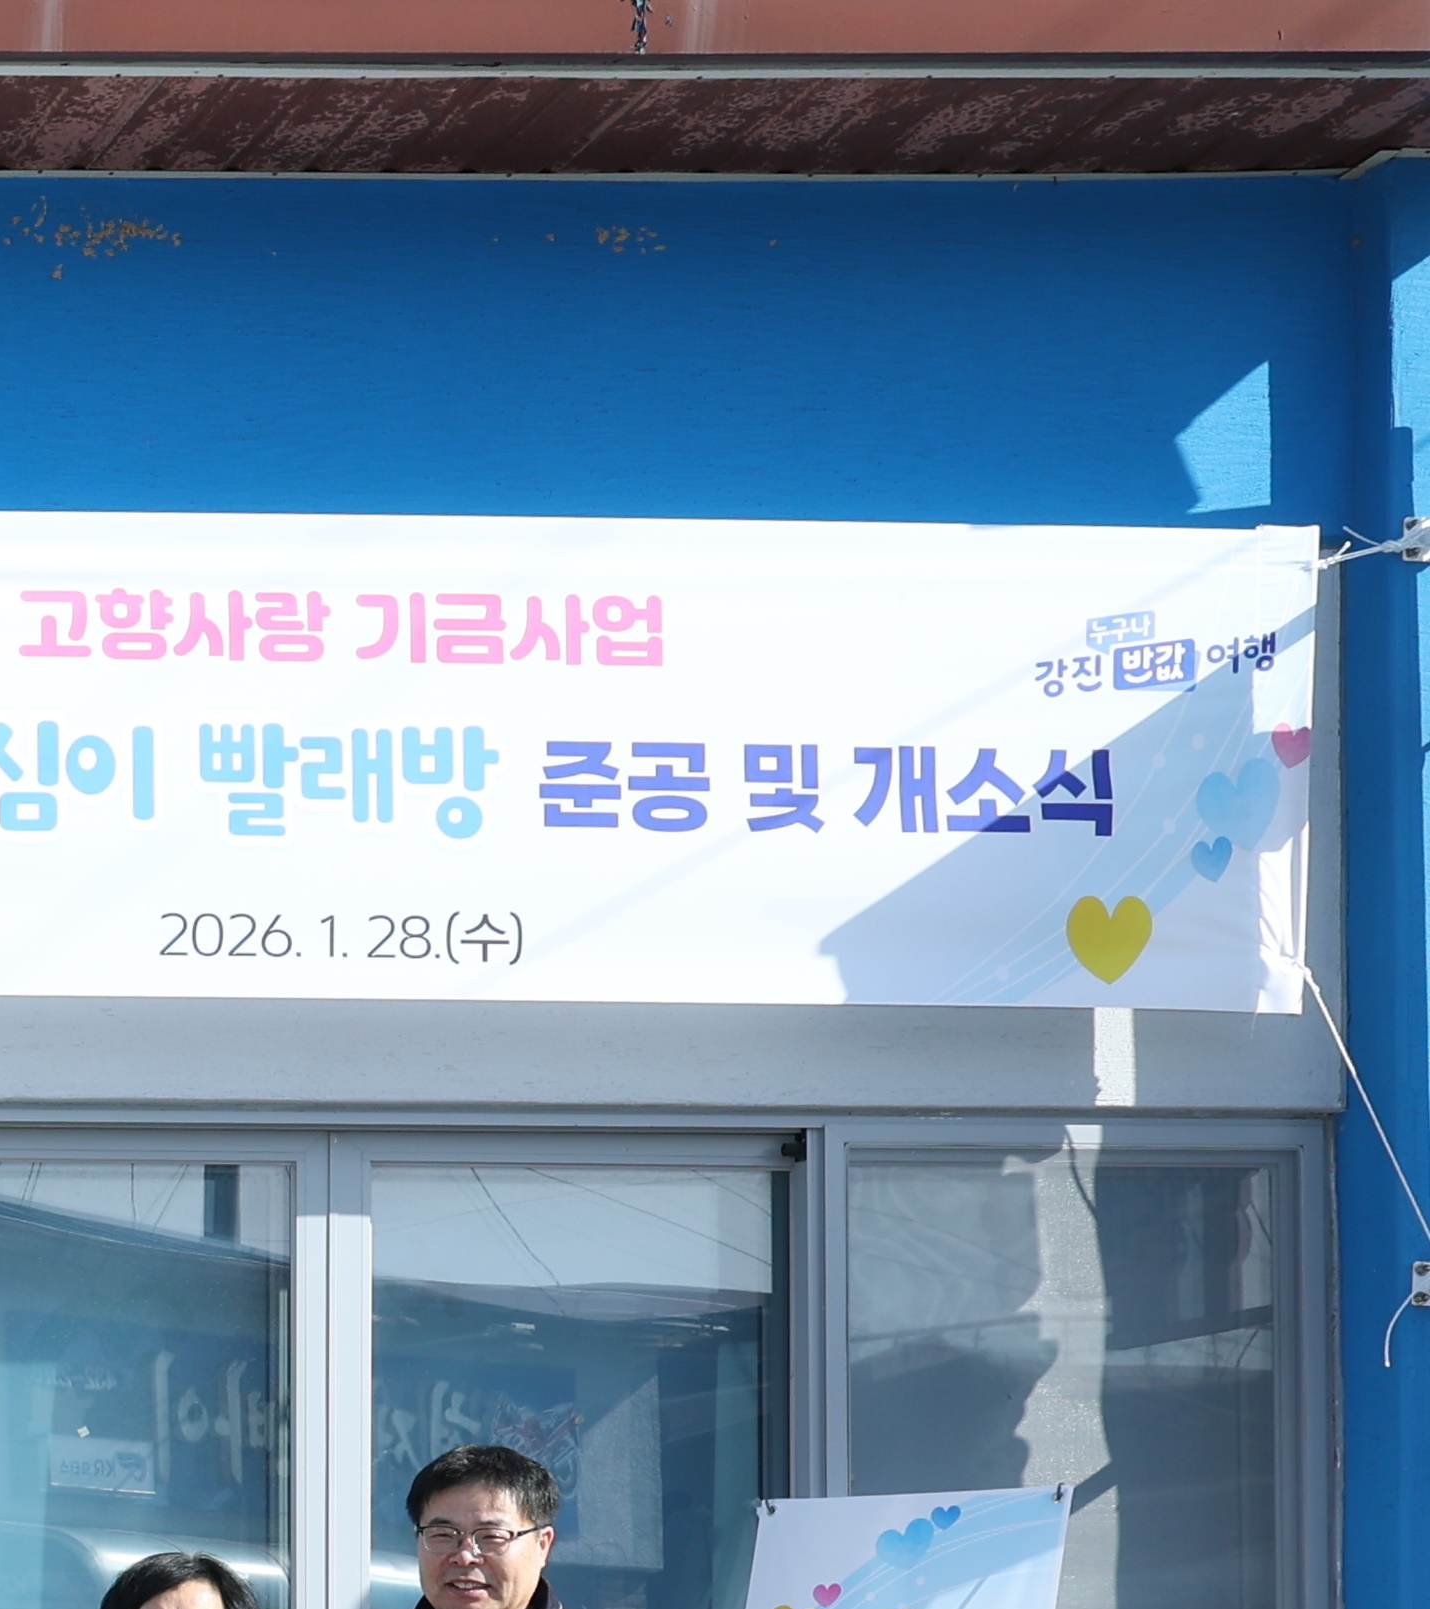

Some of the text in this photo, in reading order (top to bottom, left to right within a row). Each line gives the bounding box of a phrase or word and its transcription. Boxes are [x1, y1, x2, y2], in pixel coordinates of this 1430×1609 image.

[19, 587, 664, 667] 고향사랑 기금사업
[1088, 613, 1152, 645] 누구나
[1035, 631, 1277, 698] 강진 반값 여행
[198, 722, 501, 839] 빨래방
[539, 740, 711, 833] 준공
[743, 743, 826, 834] 및
[852, 745, 1115, 837] 개소식
[159, 911, 303, 958] 2026.
[320, 913, 349, 958] 1.
